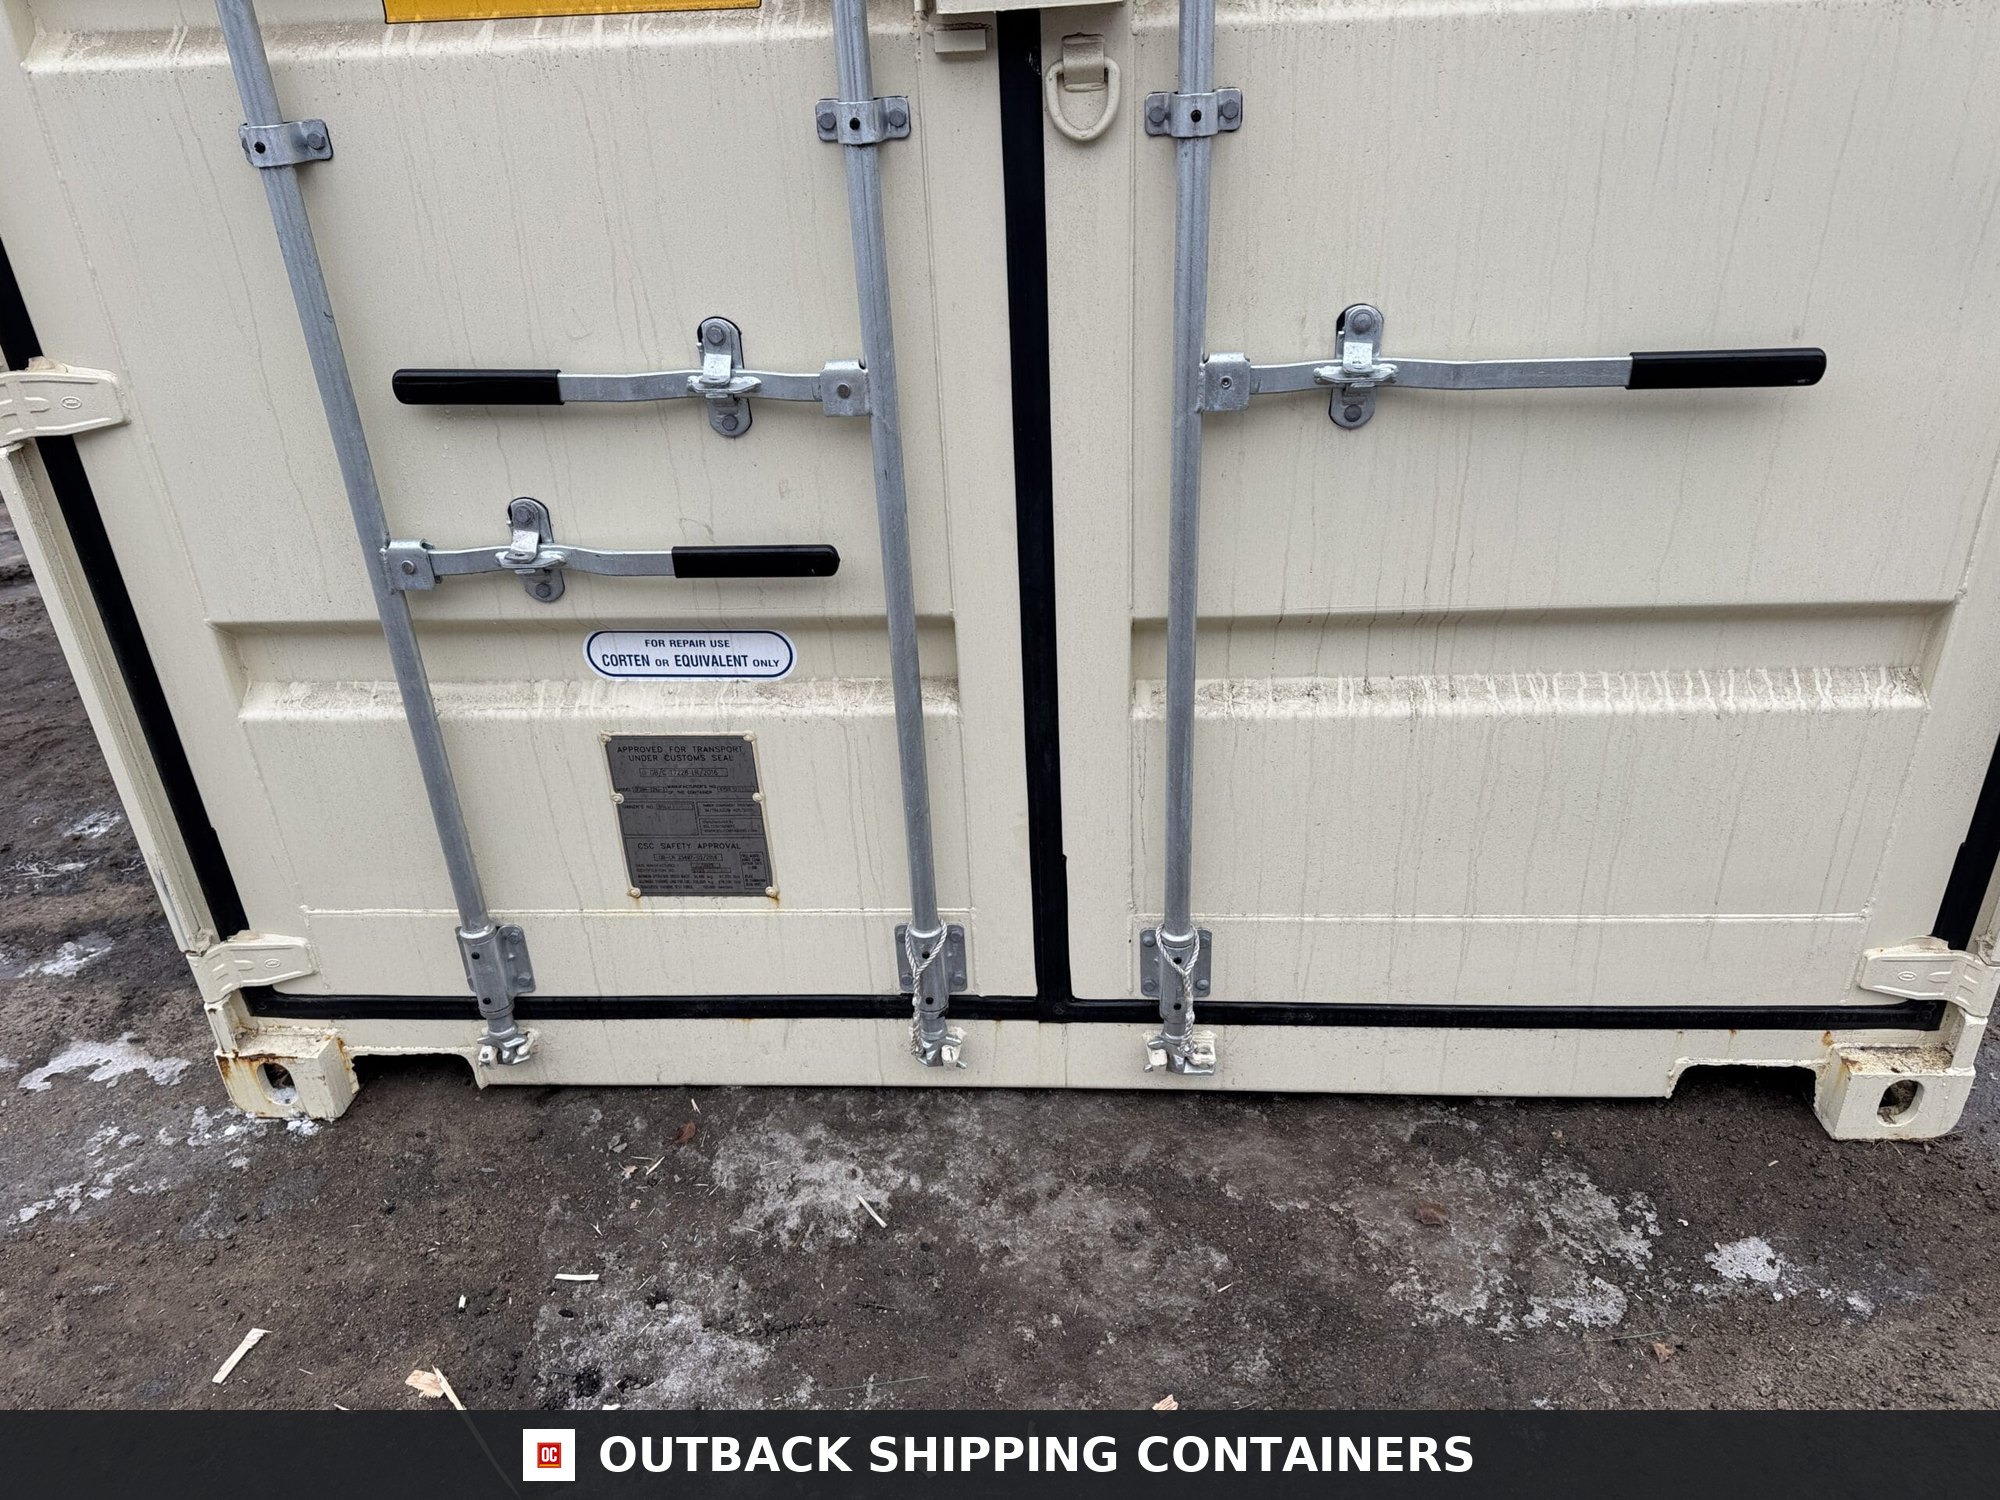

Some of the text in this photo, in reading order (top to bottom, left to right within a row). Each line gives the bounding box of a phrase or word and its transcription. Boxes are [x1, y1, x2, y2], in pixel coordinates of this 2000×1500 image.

[644, 639, 731, 648] FOR REPAIR USE
[601, 653, 780, 668] CORTEN OR EQUIVALENT ONLY
[617, 745, 743, 753] APPROVED FOR TRANSPORT
[628, 754, 734, 762] UNDER CUSTOMS SEAL
[637, 842, 741, 850] CSC SAFETY APPROVAL
